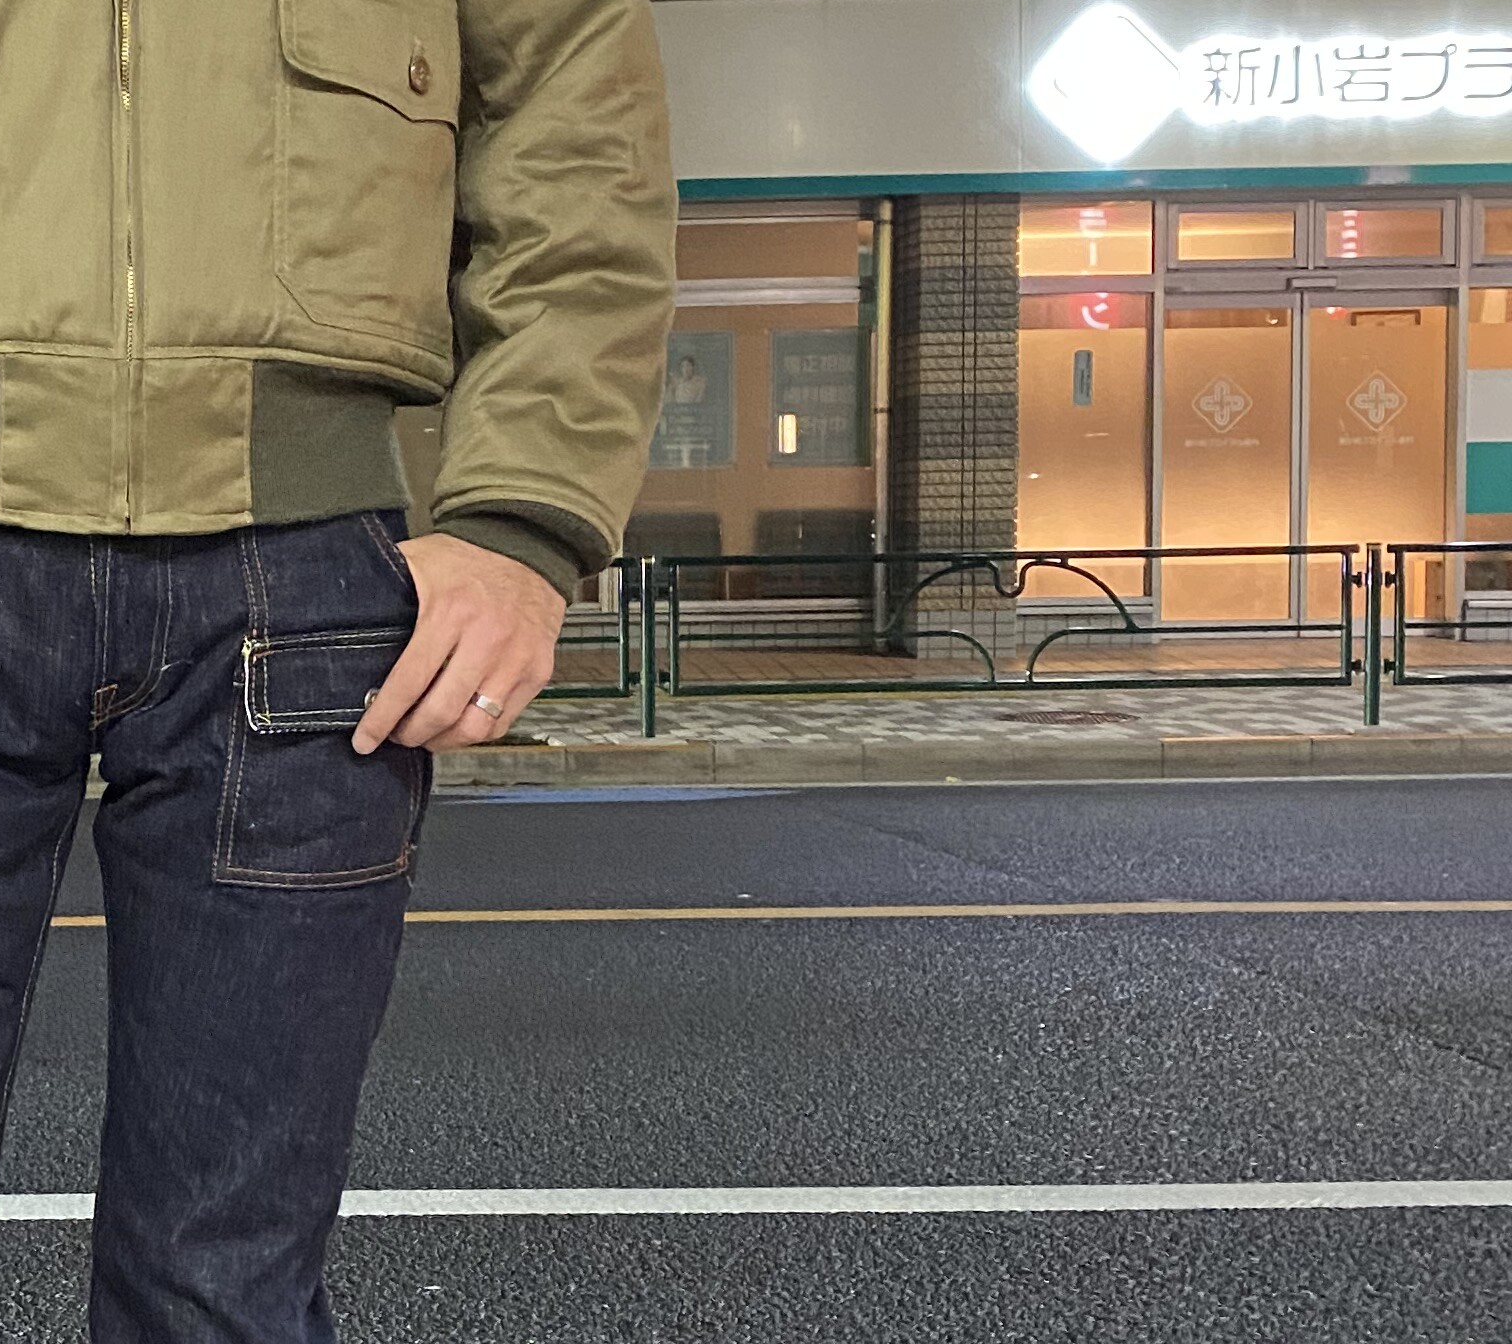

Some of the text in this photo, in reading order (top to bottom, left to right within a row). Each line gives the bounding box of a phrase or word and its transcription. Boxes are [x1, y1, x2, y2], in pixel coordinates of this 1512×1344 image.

[1202, 43, 1512, 106] 新小岩プラ
